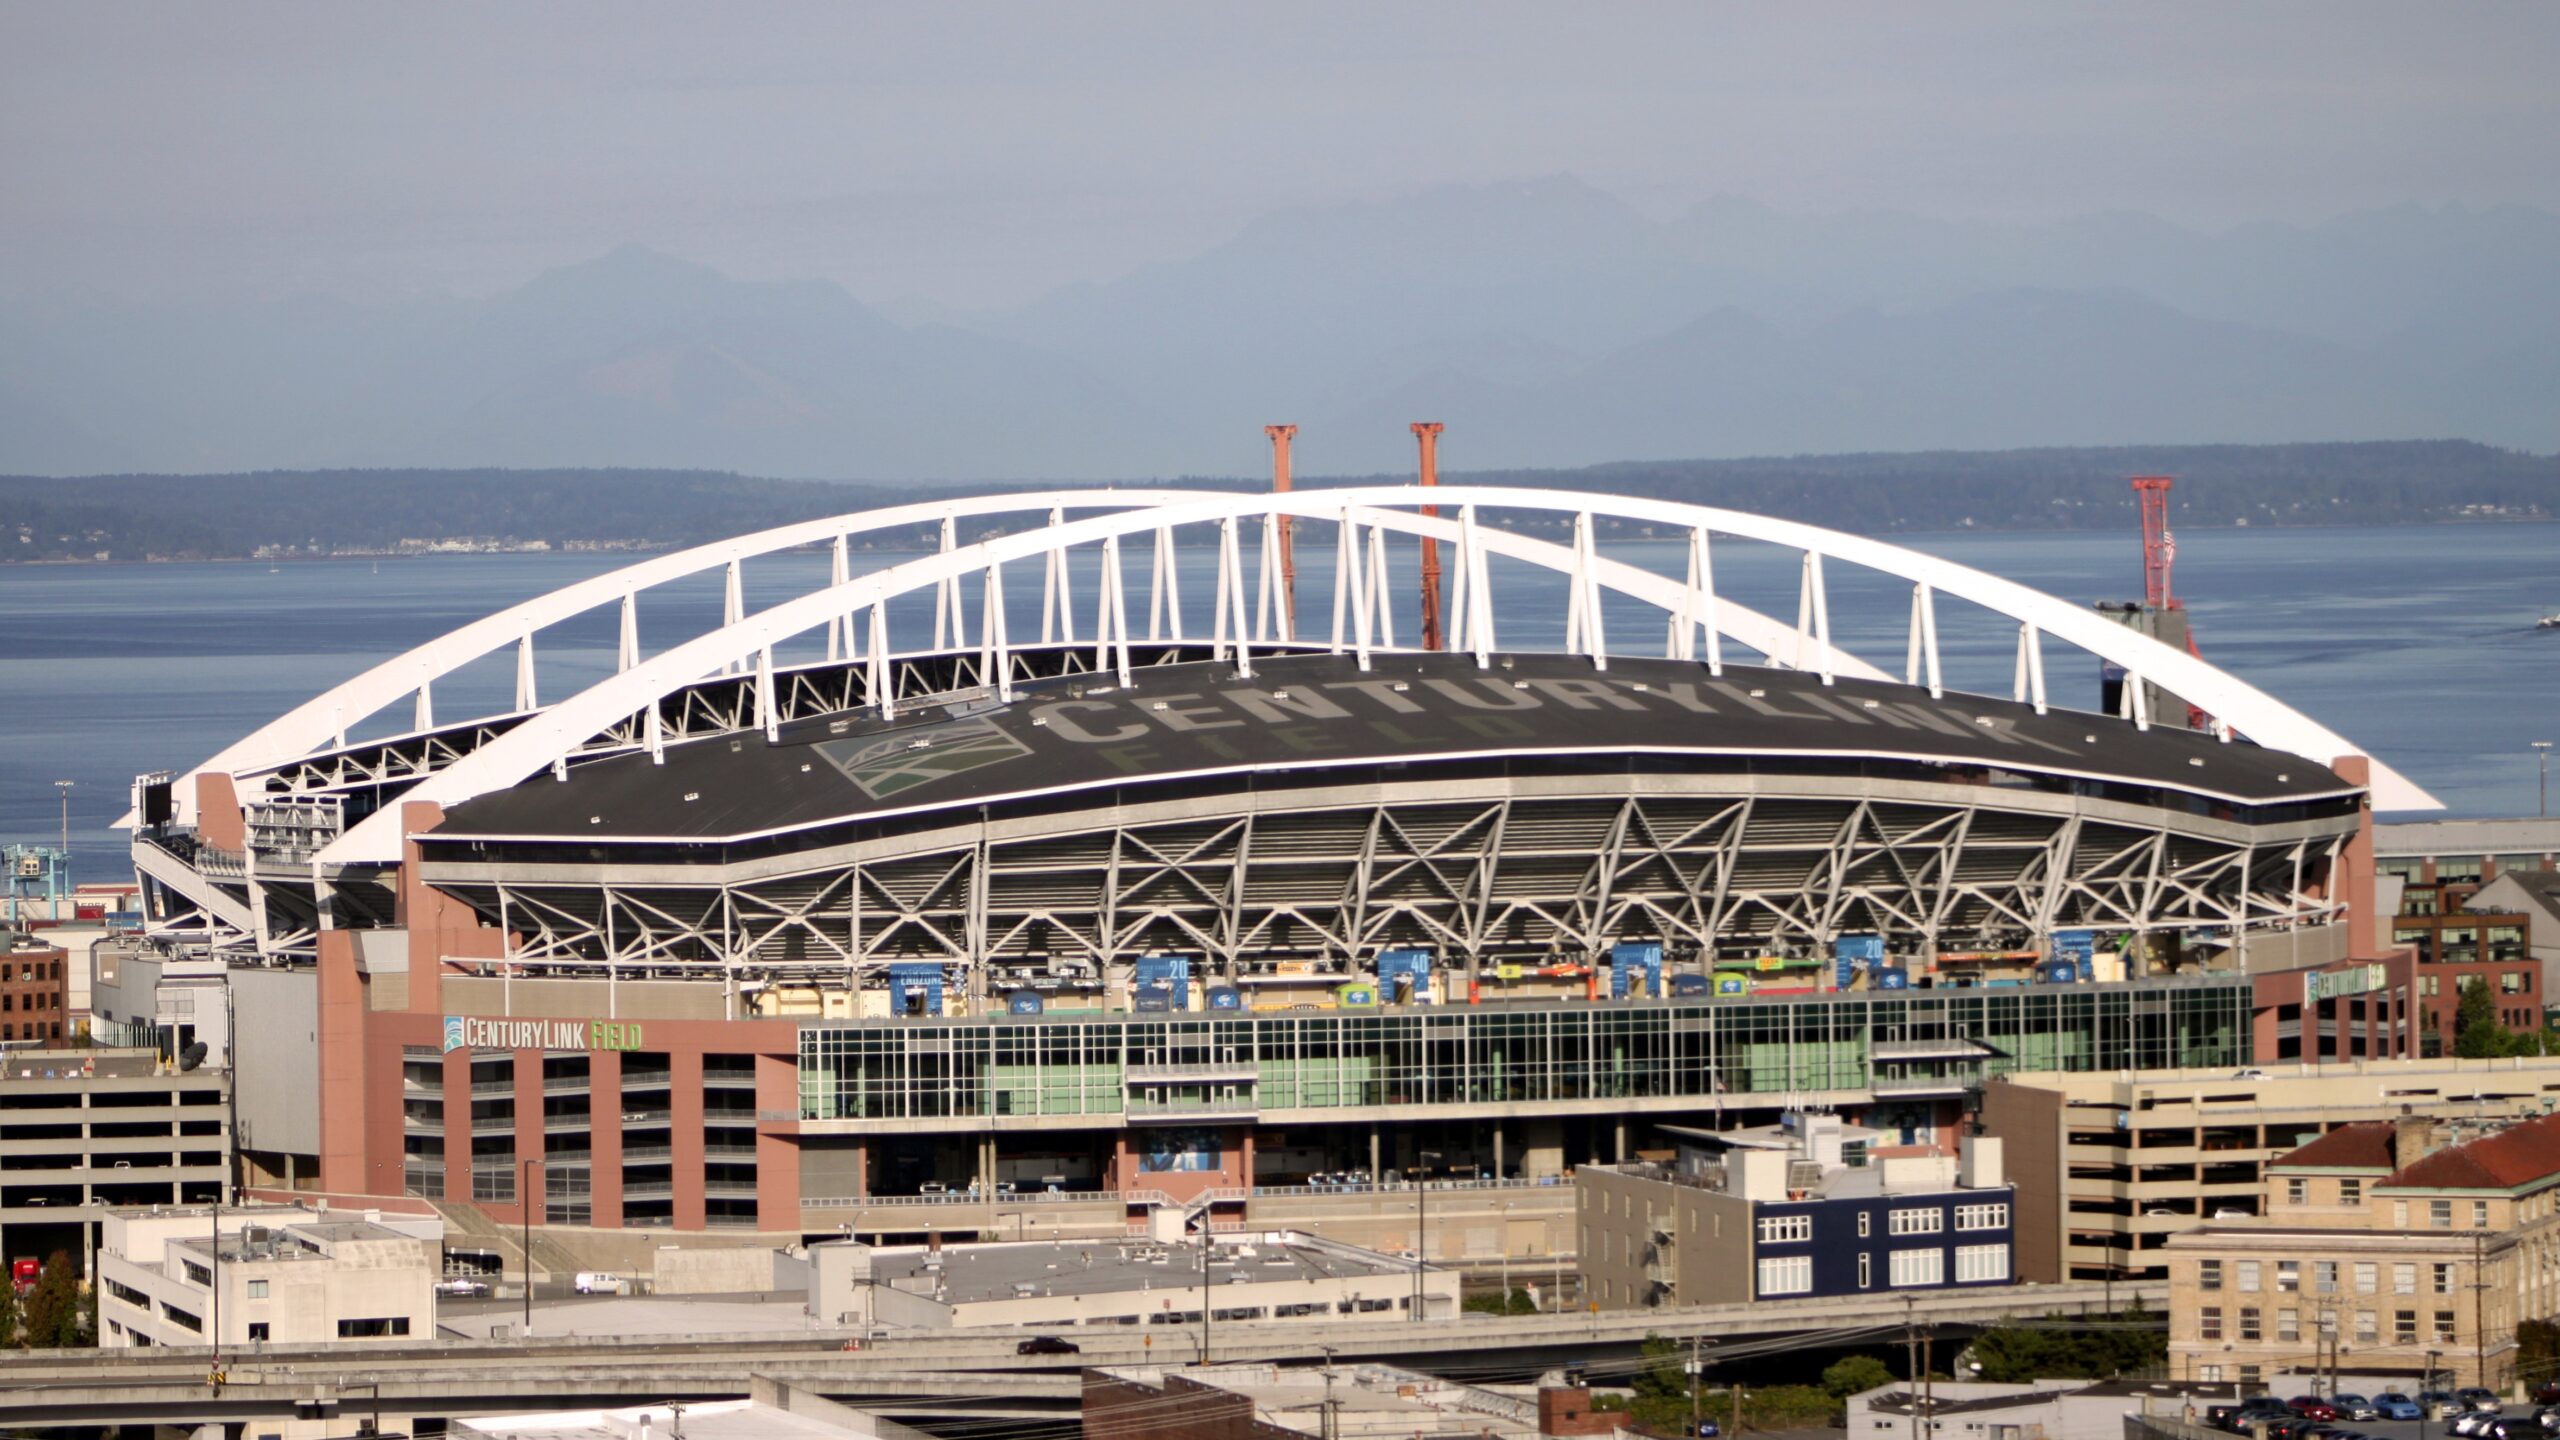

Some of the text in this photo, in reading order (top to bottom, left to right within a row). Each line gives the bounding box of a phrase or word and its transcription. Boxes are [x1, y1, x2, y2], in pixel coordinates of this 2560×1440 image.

[1029, 678, 2084, 756] CENTURYLINK
[1103, 715, 1536, 772] FIELD
[1644, 947, 1660, 966] 40
[1866, 939, 1882, 958] 20
[1169, 960, 1188, 979] 20
[1411, 954, 1428, 973] 40
[466, 1018, 642, 1050] CENTURYLINK FIELD
